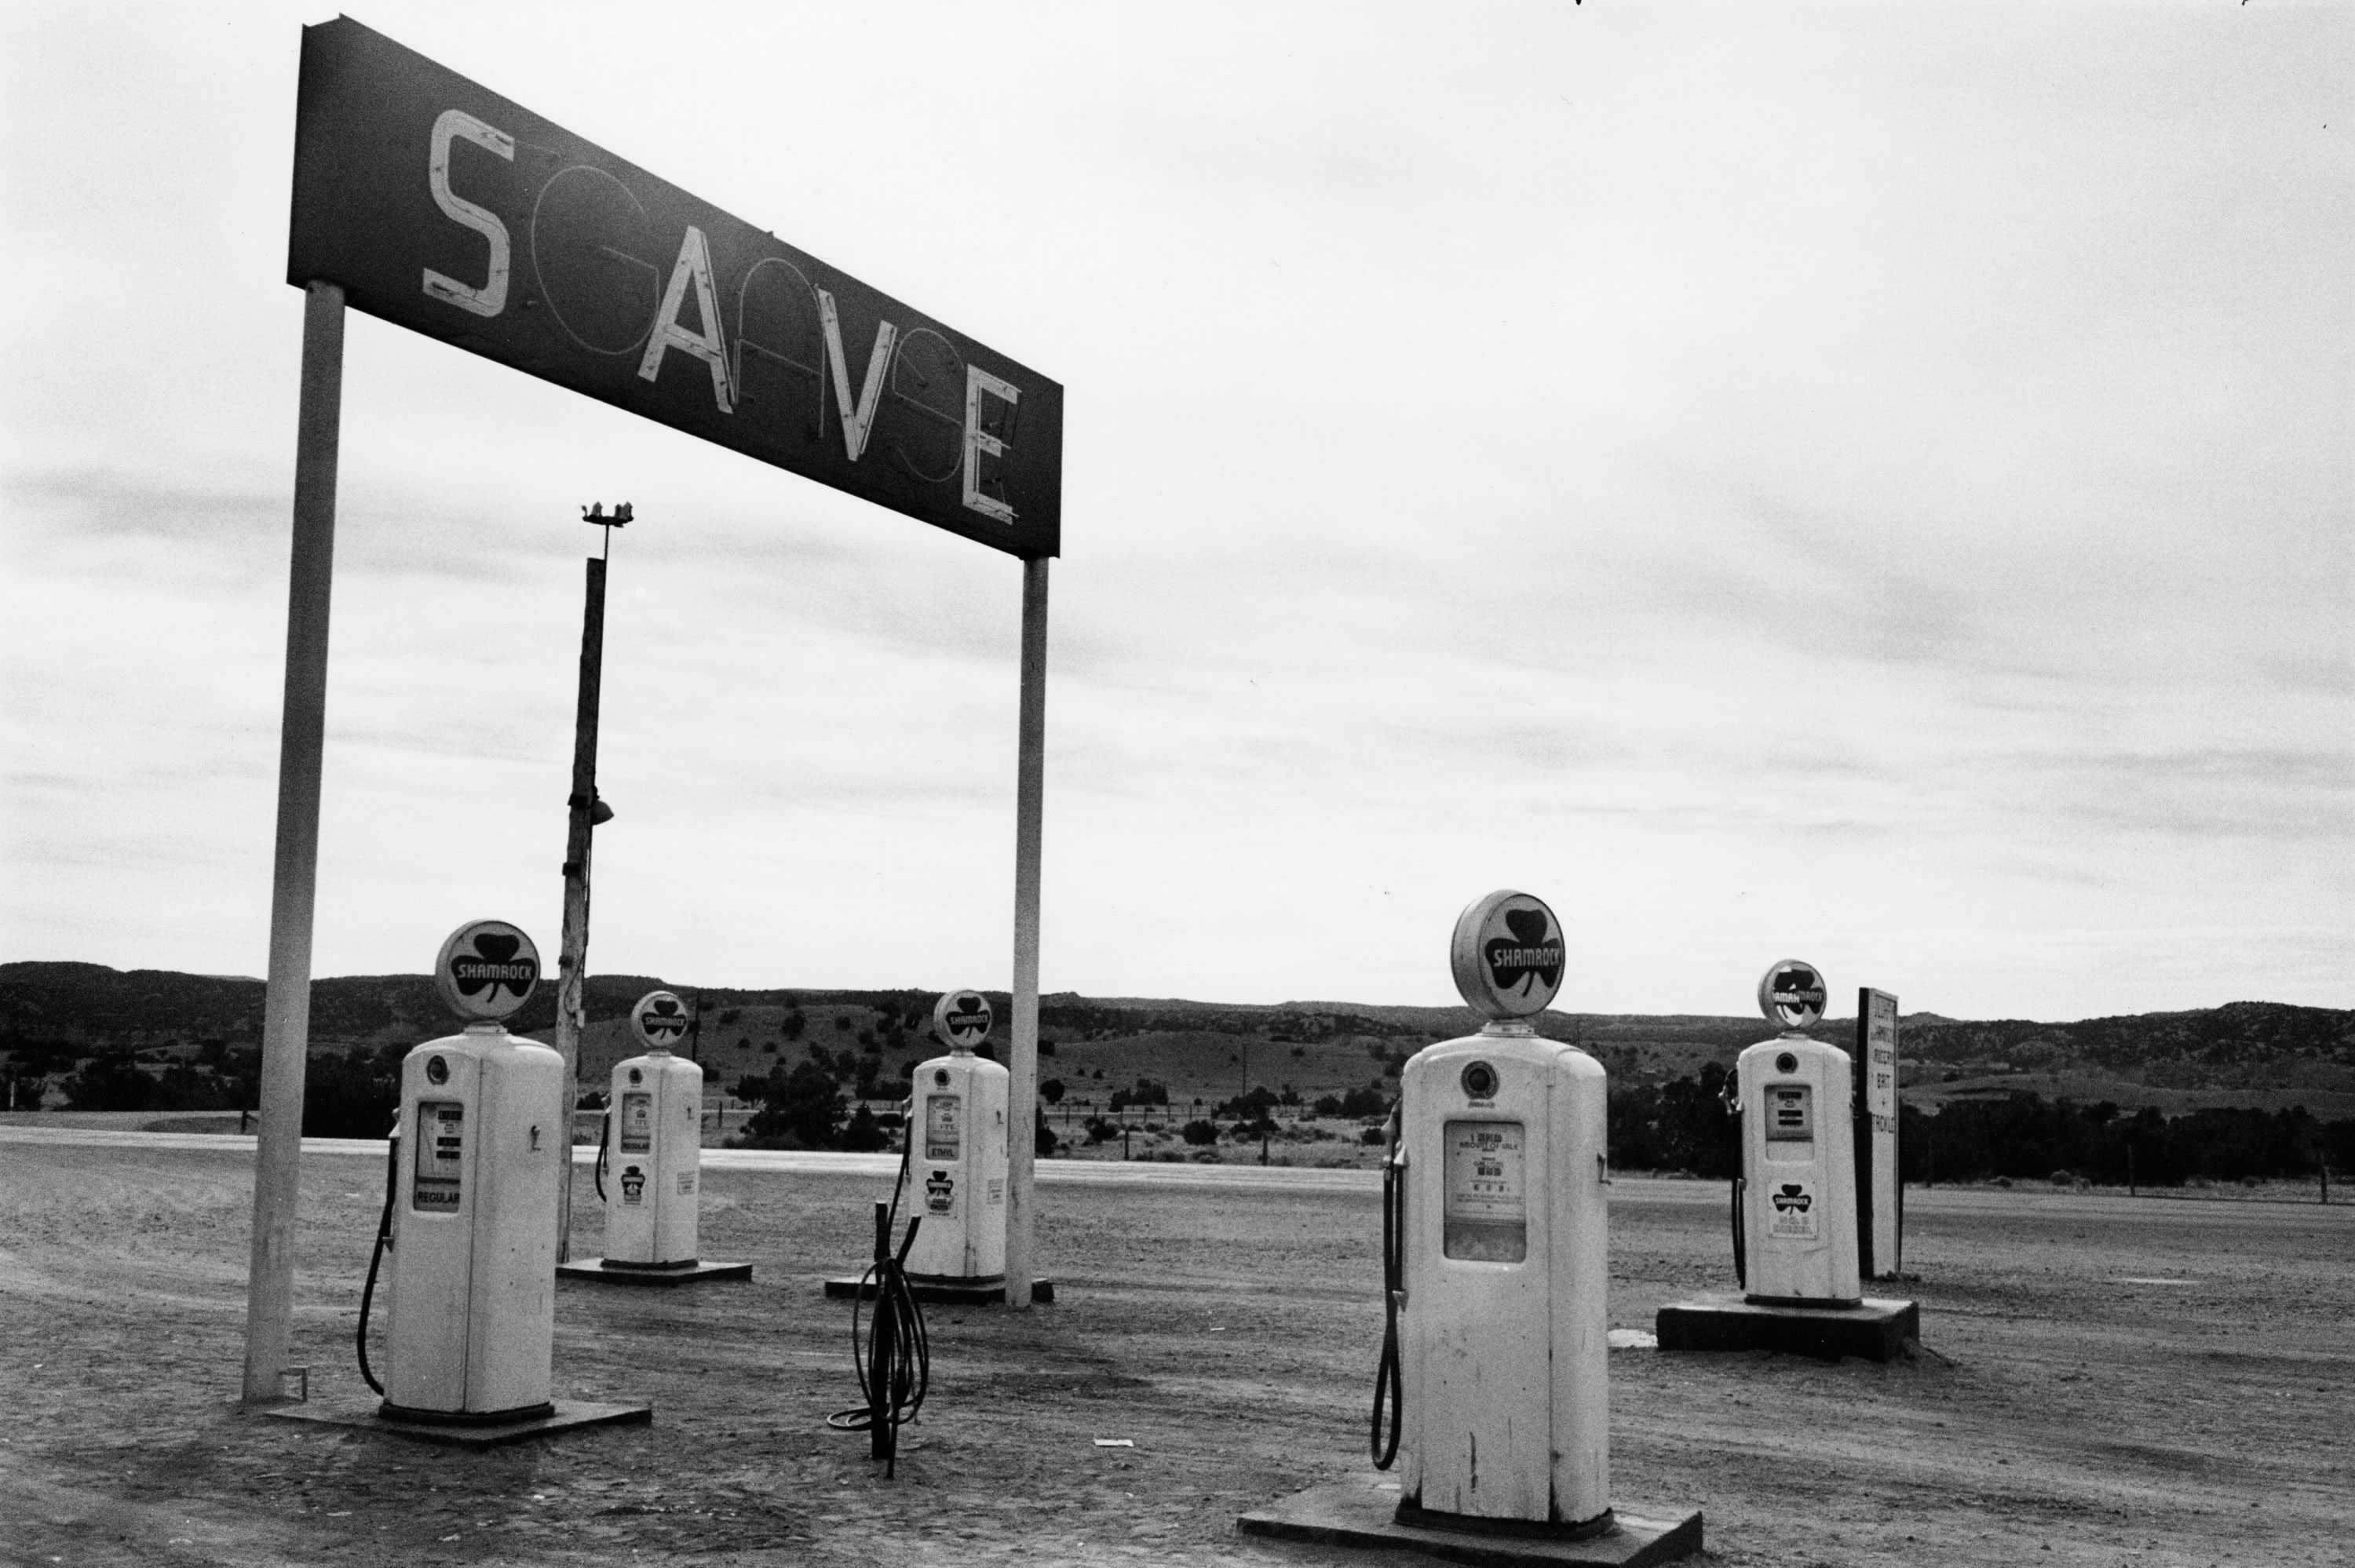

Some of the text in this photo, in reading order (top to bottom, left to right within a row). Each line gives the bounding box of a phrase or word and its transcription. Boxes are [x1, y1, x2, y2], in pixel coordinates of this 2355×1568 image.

[422, 108, 1021, 525] SAVE
[1493, 948, 1561, 968] SHAMROCK
[457, 962, 533, 981] SHAMROCK
[644, 1015, 688, 1027] SHAMROCK
[950, 1014, 989, 1026] SHAMROCK
[622, 1141, 650, 1151] REGULAR
[931, 1147, 955, 1158] ETHYL
[416, 1191, 461, 1205] REGULAR
[1775, 1197, 1809, 1205] SHAMROCK
[1773, 1224, 1813, 1234] DIESEL
